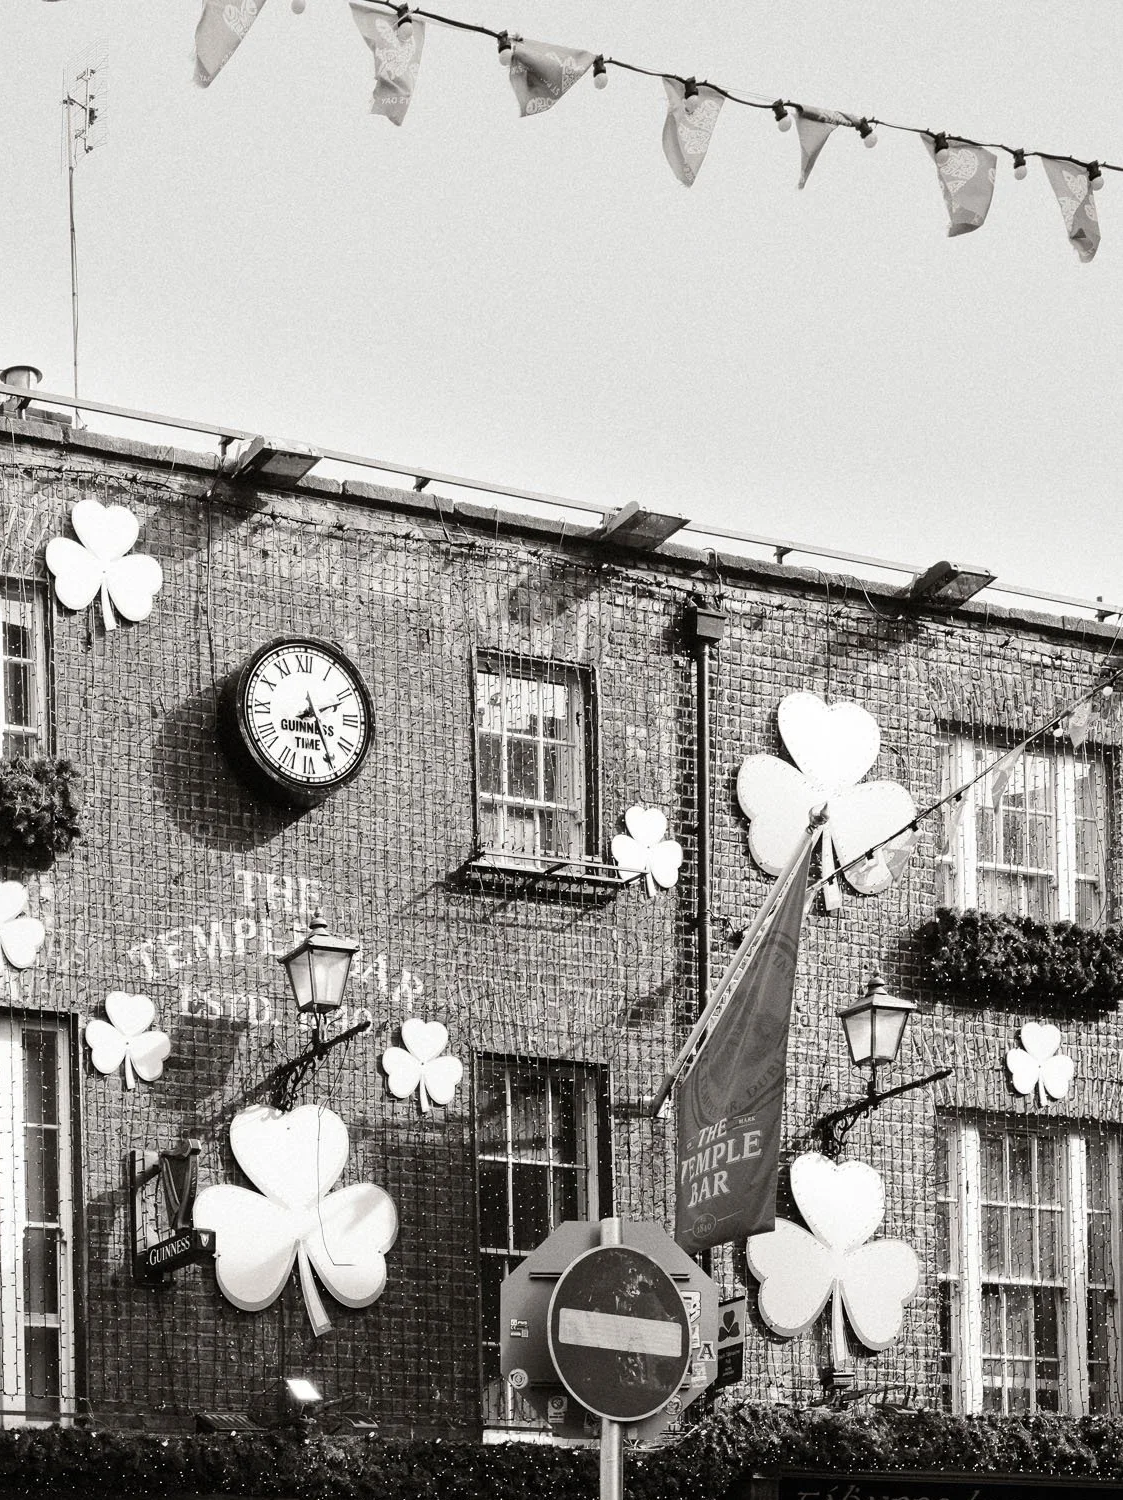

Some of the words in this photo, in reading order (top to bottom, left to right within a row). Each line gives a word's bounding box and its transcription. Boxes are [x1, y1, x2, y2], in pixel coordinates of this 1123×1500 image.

[274, 658, 291, 679] XI
[296, 655, 313, 673] XII
[260, 675, 276, 691] X
[336, 688, 353, 701] II
[281, 719, 334, 737] GUINNESS
[343, 714, 358, 728] III
[295, 736, 321, 750] TIME
[234, 870, 322, 913] THE
[350, 948, 424, 1012] AR
[697, 1117, 728, 1148] THE
[680, 1130, 763, 1185] TEMPLE
[687, 1170, 730, 1208] BAR
[149, 1235, 192, 1266] GUINNESS
